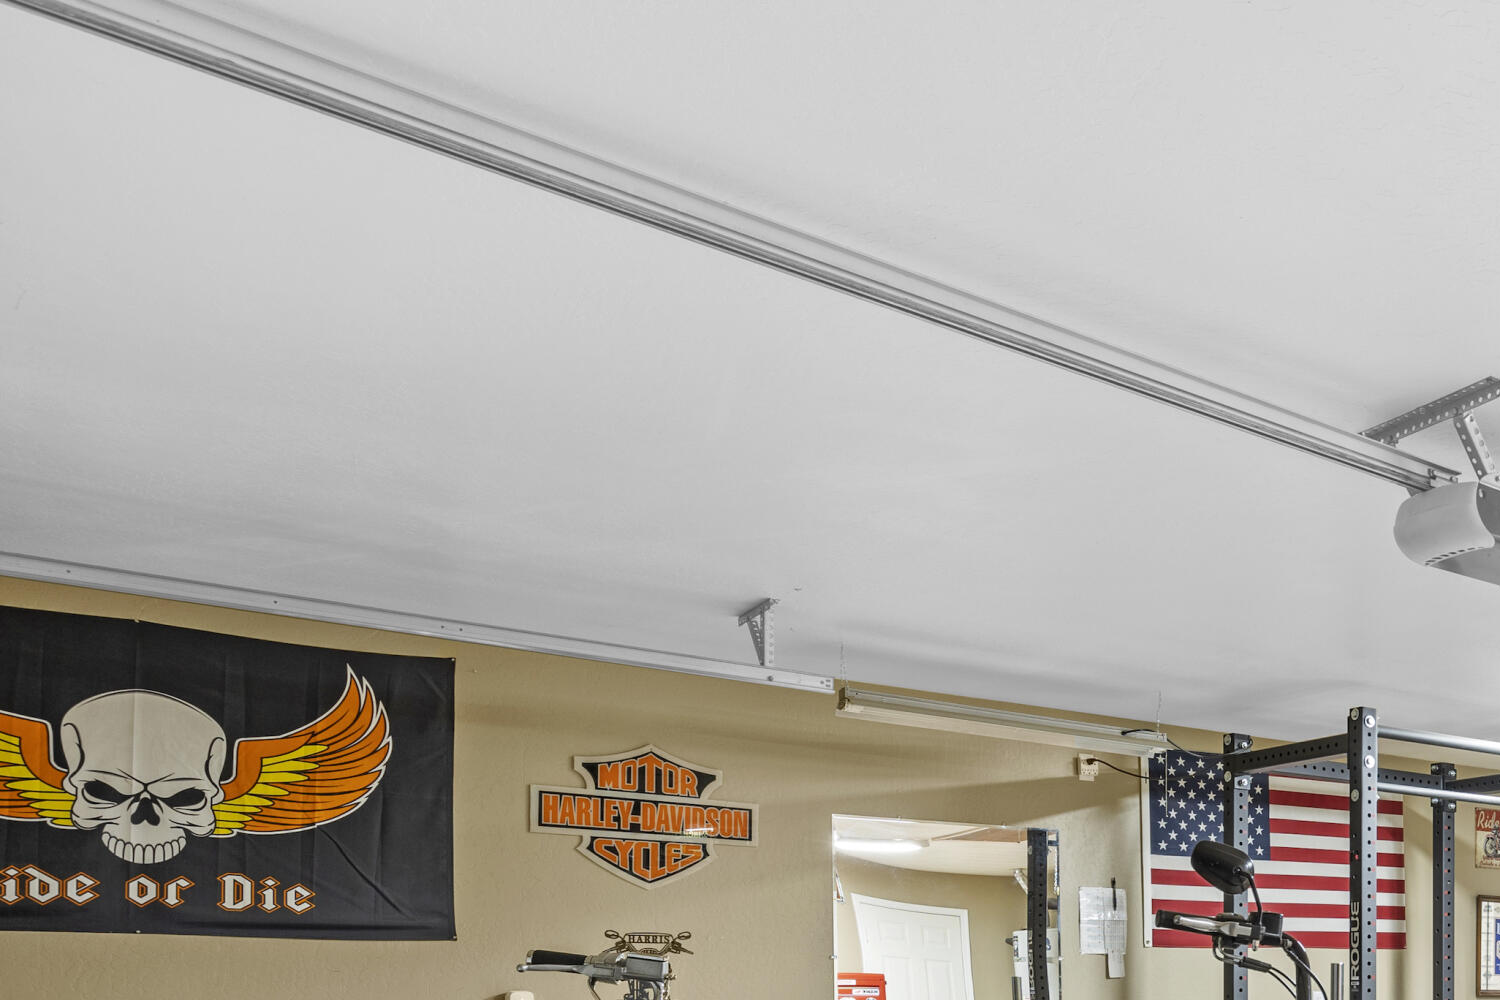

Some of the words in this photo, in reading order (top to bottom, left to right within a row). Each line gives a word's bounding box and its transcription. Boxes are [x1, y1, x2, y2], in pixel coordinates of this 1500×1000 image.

[598, 754, 699, 798] MOTOR
[541, 793, 750, 840] HARLEY-DAVIDSON
[1477, 811, 1500, 829] Ride
[594, 838, 703, 882] CYCLES
[0, 864, 101, 906] ide
[125, 873, 195, 908] or
[217, 872, 316, 914] Die
[628, 934, 670, 944] HARRIS
[1350, 901, 1361, 981] ROGUE
